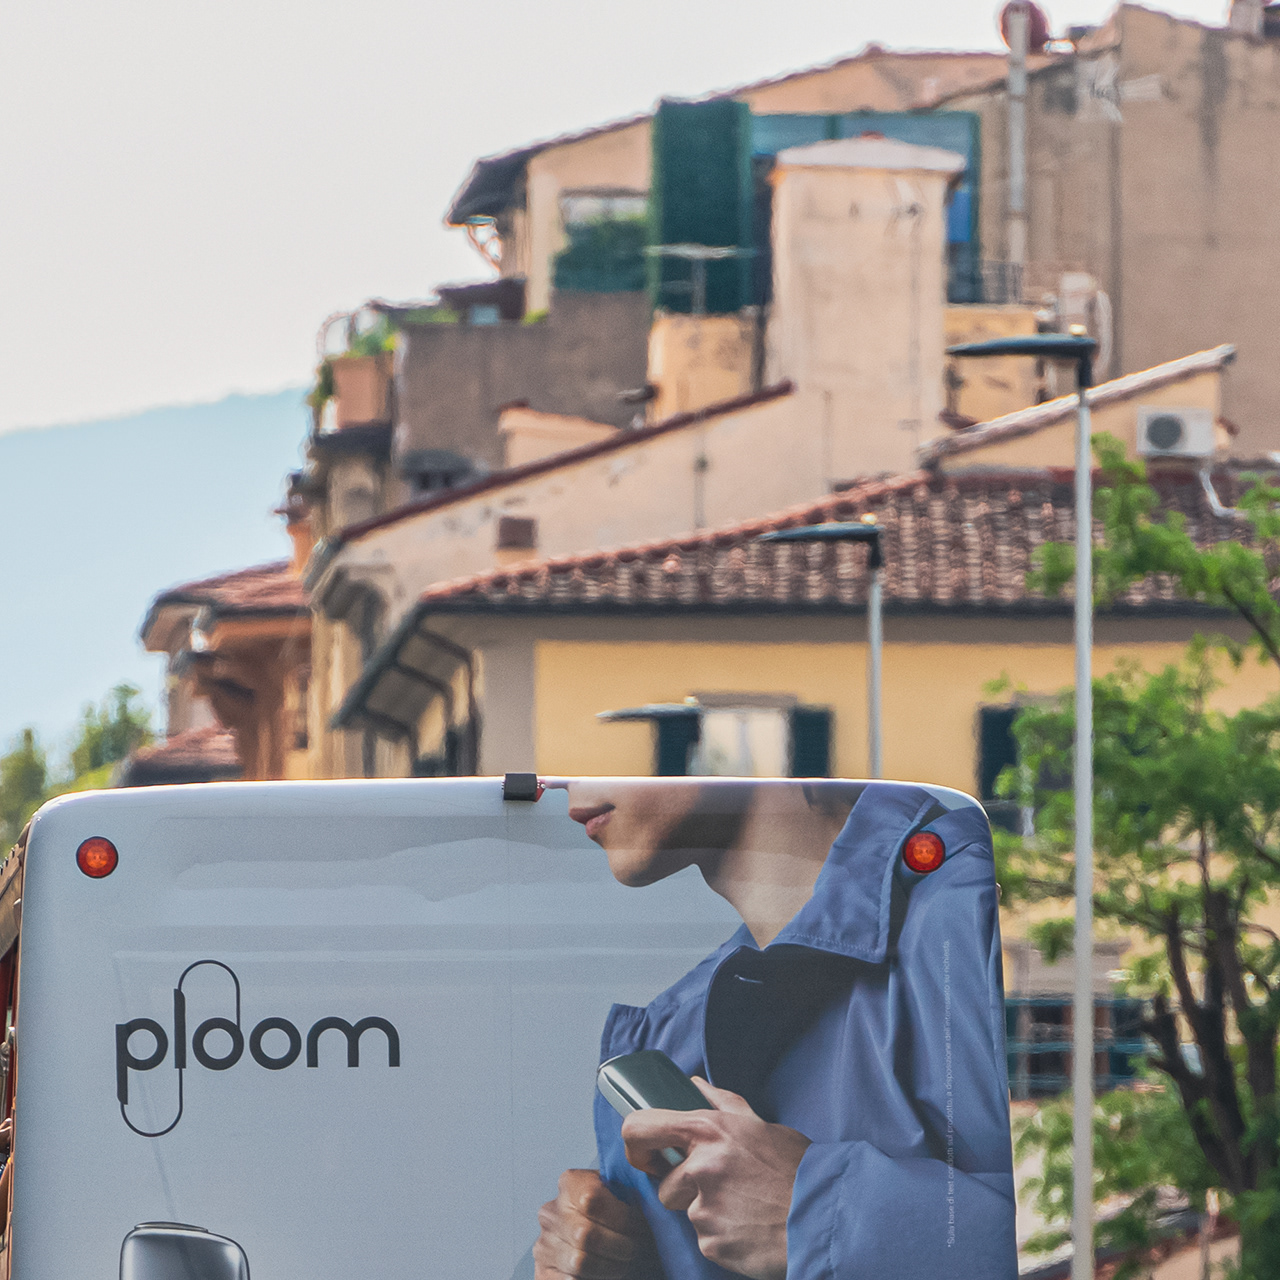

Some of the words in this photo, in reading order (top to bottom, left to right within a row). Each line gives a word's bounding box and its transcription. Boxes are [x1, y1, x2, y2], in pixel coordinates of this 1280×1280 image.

[944, 975, 951, 983] su
[116, 959, 401, 1137] ploom
[946, 1134, 954, 1146] sul
[946, 1181, 955, 1195] test
[946, 1196, 955, 1205] di
[946, 1206, 955, 1224] base
